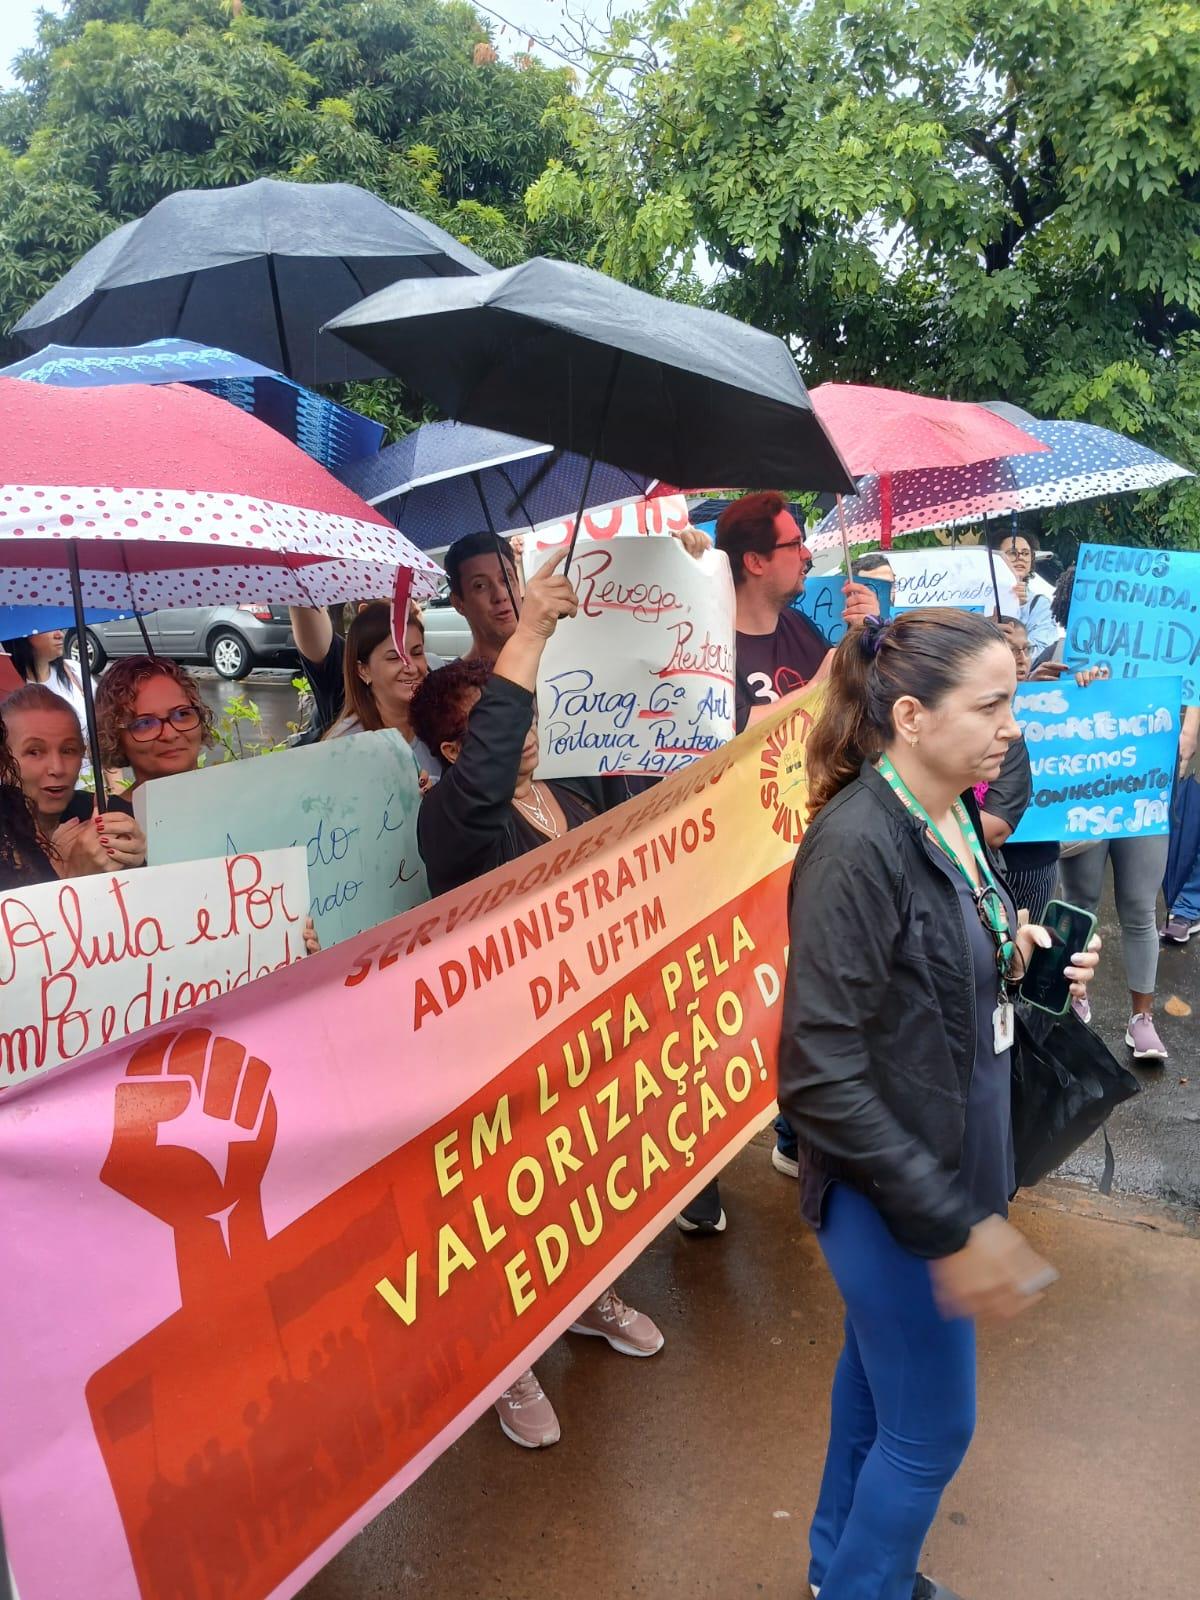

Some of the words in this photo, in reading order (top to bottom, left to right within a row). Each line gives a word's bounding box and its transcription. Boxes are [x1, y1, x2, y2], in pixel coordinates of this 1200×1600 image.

[1081, 550, 1170, 578] MENOS
[638, 750, 701, 773] 49/2
[1031, 746, 1137, 776] UEREMOS
[413, 807, 717, 1031] ADMINISTRATIVOS
[528, 958, 581, 1020] DA
[586, 896, 667, 977] UFTM
[434, 1094, 513, 1198] EM
[536, 992, 650, 1114] LUTA
[661, 914, 756, 1011] PELA
[374, 991, 743, 1327] VALORIZAÇÃO
[503, 1038, 768, 1317] EDUCAÇÃO!
